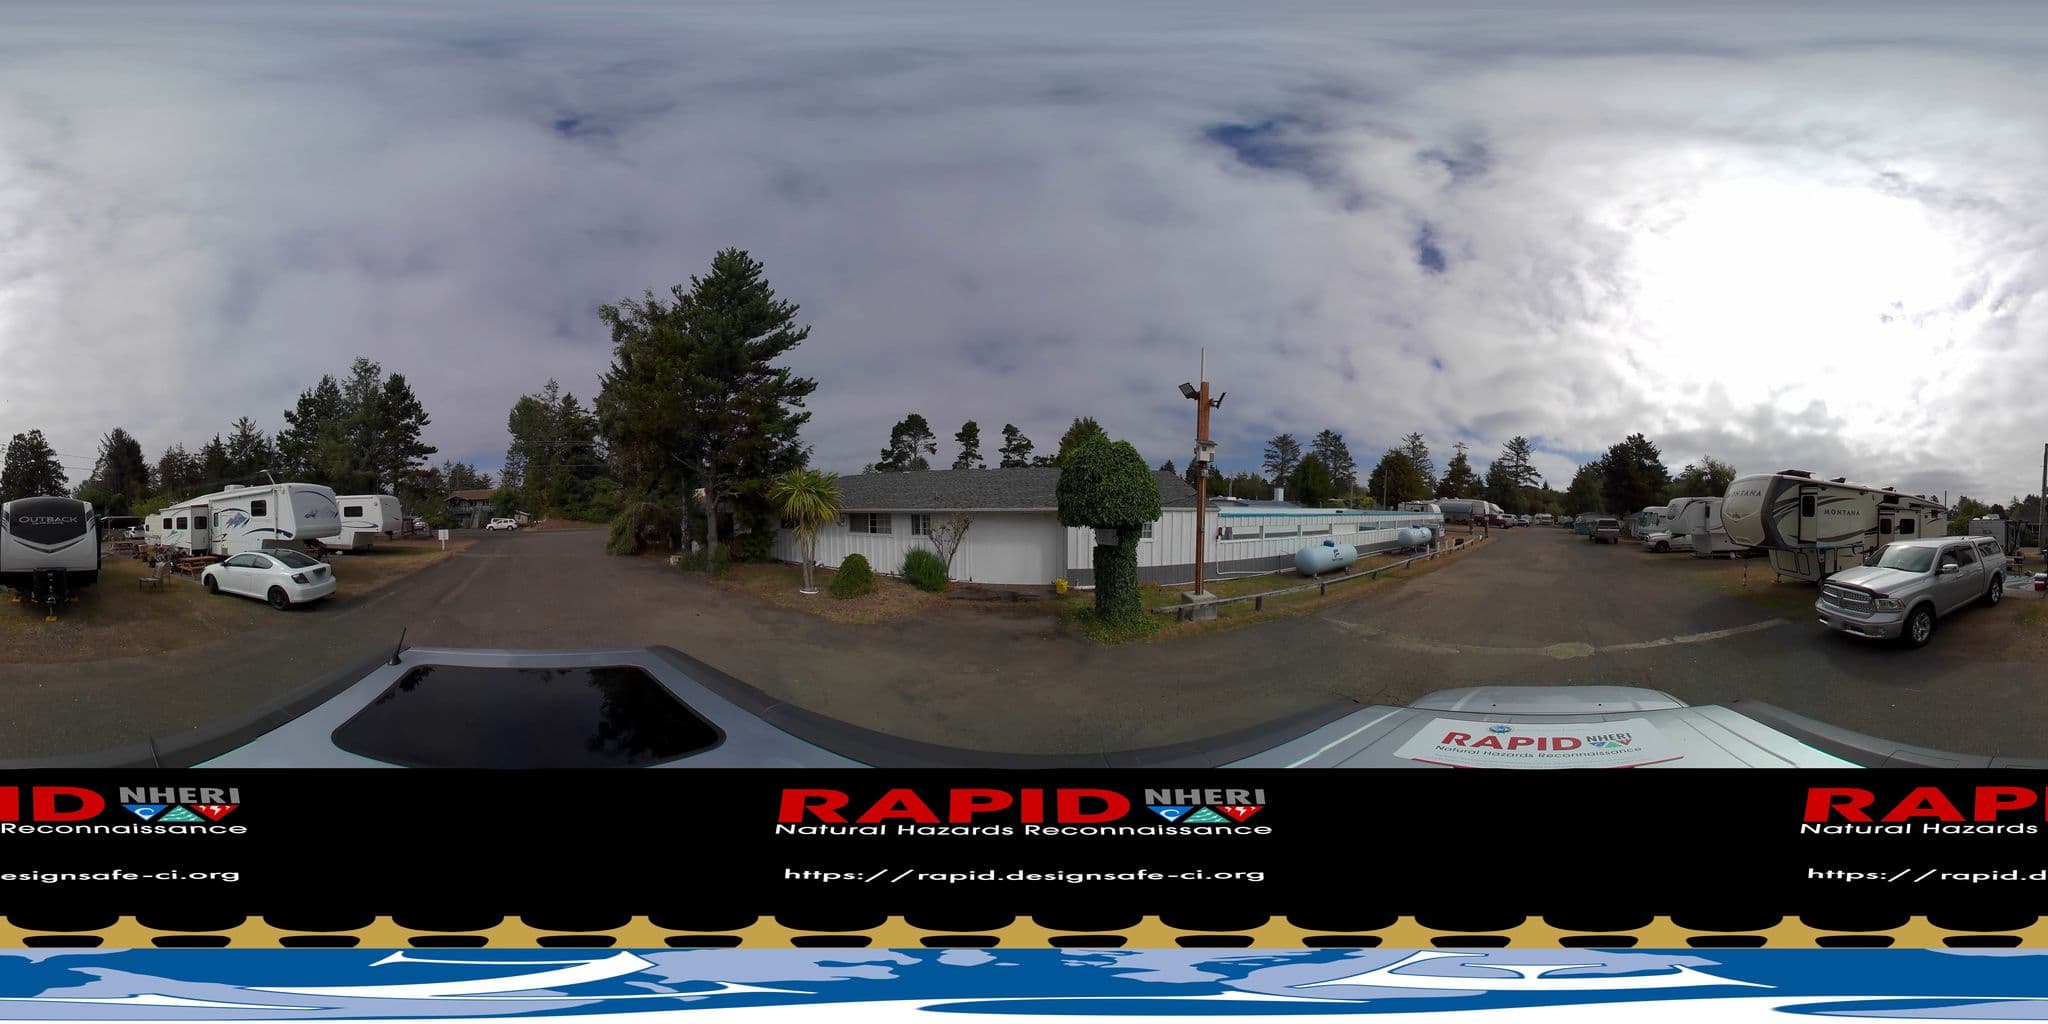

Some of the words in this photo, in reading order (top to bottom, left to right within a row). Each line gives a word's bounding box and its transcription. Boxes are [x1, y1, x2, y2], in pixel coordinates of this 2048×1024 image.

[1823, 508, 1861, 516] MONTANA
[18, 515, 79, 523] OUTBACK
[1441, 731, 1582, 751] RAPID
[1586, 732, 1632, 743] NHERI
[1434, 745, 1480, 755] Natural
[1538, 747, 1642, 758] Reconnaissance
